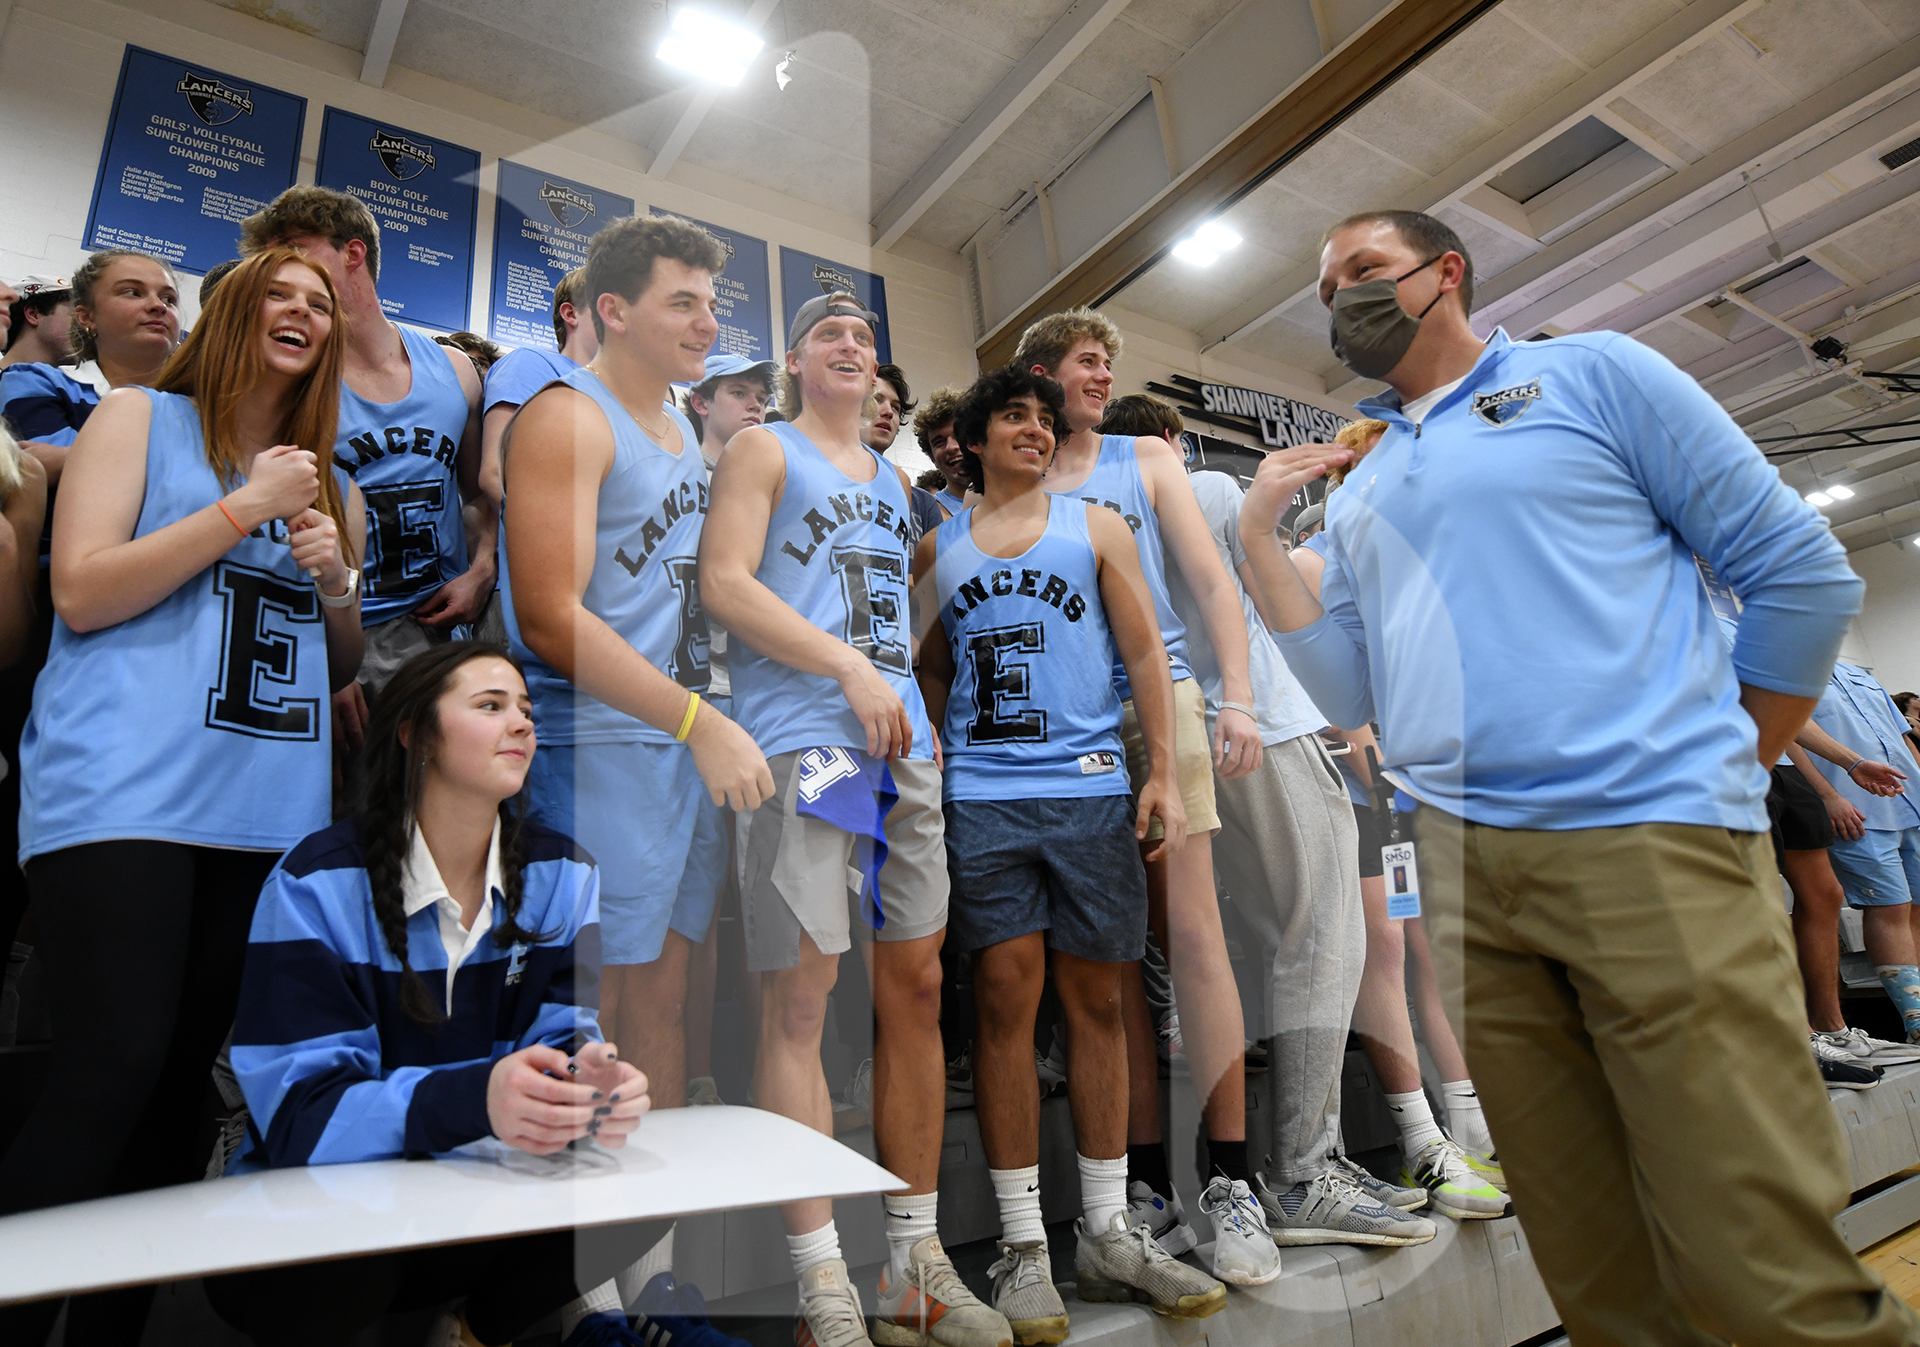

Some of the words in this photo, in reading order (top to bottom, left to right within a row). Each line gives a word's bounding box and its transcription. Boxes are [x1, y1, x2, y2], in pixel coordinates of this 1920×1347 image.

[180, 82, 251, 109] LANCERS
[151, 115, 190, 131] GIRLS'
[193, 126, 265, 154] VOLLEYBALL
[145, 125, 218, 153] SUNFLOWER
[222, 147, 266, 167] LEAGUE
[373, 140, 435, 164] LANCERS
[168, 145, 240, 172] CHAMPIONS
[124, 165, 142, 175] Julie
[187, 163, 217, 179] 2009
[120, 188, 141, 198] Taylor
[122, 176, 147, 188] Lauren
[148, 184, 165, 193] King
[150, 178, 182, 191] Dahlgren
[204, 186, 238, 200] Alexandra
[370, 180, 400, 194] BOYS'
[403, 189, 429, 202] GOLF
[203, 192, 226, 203] Hayley
[203, 197, 228, 209] Lindsey
[346, 185, 409, 209] SUNFLOWER
[411, 202, 449, 220] LEAGUE
[541, 190, 594, 212] LANCERS
[200, 209, 221, 219] Logan
[201, 203, 227, 214] Monica
[367, 203, 428, 226] CHAMPIONS
[383, 219, 409, 233] 2009
[523, 218, 552, 232] GIRLS'
[95, 238, 130, 250] Manager:
[96, 231, 115, 241] Asst.
[116, 236, 141, 247] Coach:
[143, 242, 162, 252] Barry
[164, 247, 184, 257] Lenth
[98, 224, 117, 235] Head
[118, 229, 143, 241] Coach:
[144, 235, 164, 245] Scott
[165, 240, 187, 251] Dowis
[521, 229, 575, 250] SUNFLOWER
[815, 271, 855, 289] LANCERS
[720, 288, 750, 302] LEAGUE
[1201, 384, 1291, 424] SHAWNEE
[1473, 386, 1537, 412] LANCERS
[361, 478, 445, 598] E
[829, 545, 911, 678] E
[205, 559, 322, 742] E
[965, 620, 1047, 747] E
[1102, 754, 1114, 764] M
[1385, 850, 1411, 863] SMSD
